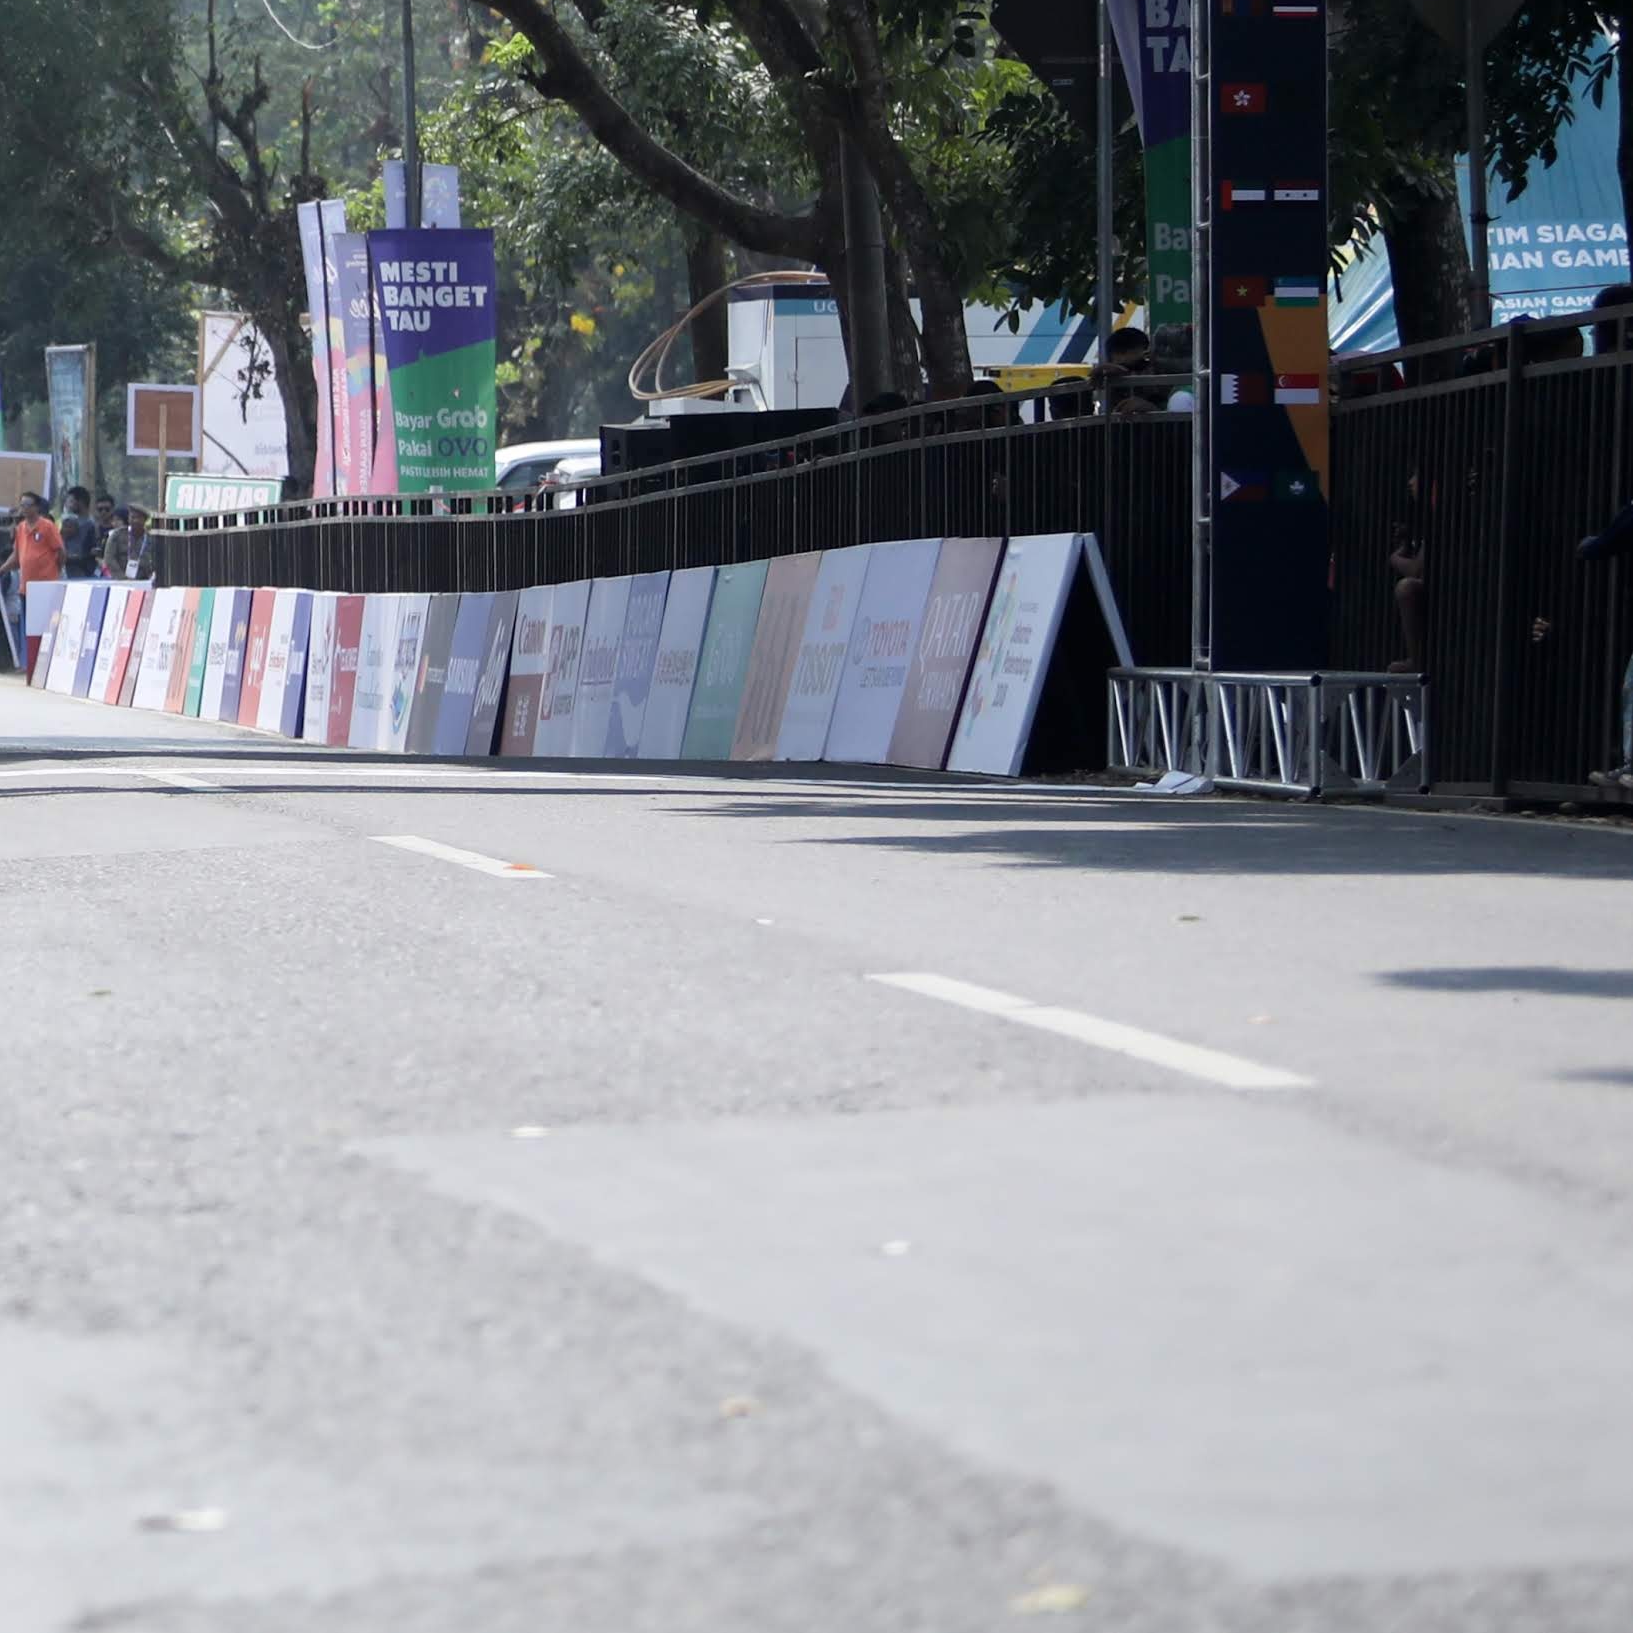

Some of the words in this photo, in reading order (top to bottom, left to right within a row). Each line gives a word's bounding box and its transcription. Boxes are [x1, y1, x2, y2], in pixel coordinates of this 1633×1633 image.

[1536, 223, 1628, 244] SIAGA
[1488, 250, 1544, 270] IAN
[380, 261, 458, 284] MESTI
[383, 285, 488, 308] BANGET
[1492, 297, 1547, 310] ASIAN
[1551, 294, 1596, 308] GAM
[386, 309, 432, 333] TAU
[395, 411, 433, 432] Bayar
[436, 404, 488, 428] Grab
[397, 439, 432, 457] Pakai
[437, 436, 488, 458] OVO
[453, 466, 488, 478] HEMAT
[869, 620, 911, 657] TOYOTA
[918, 591, 981, 673] QATAR
[793, 642, 847, 697] TISSOT
